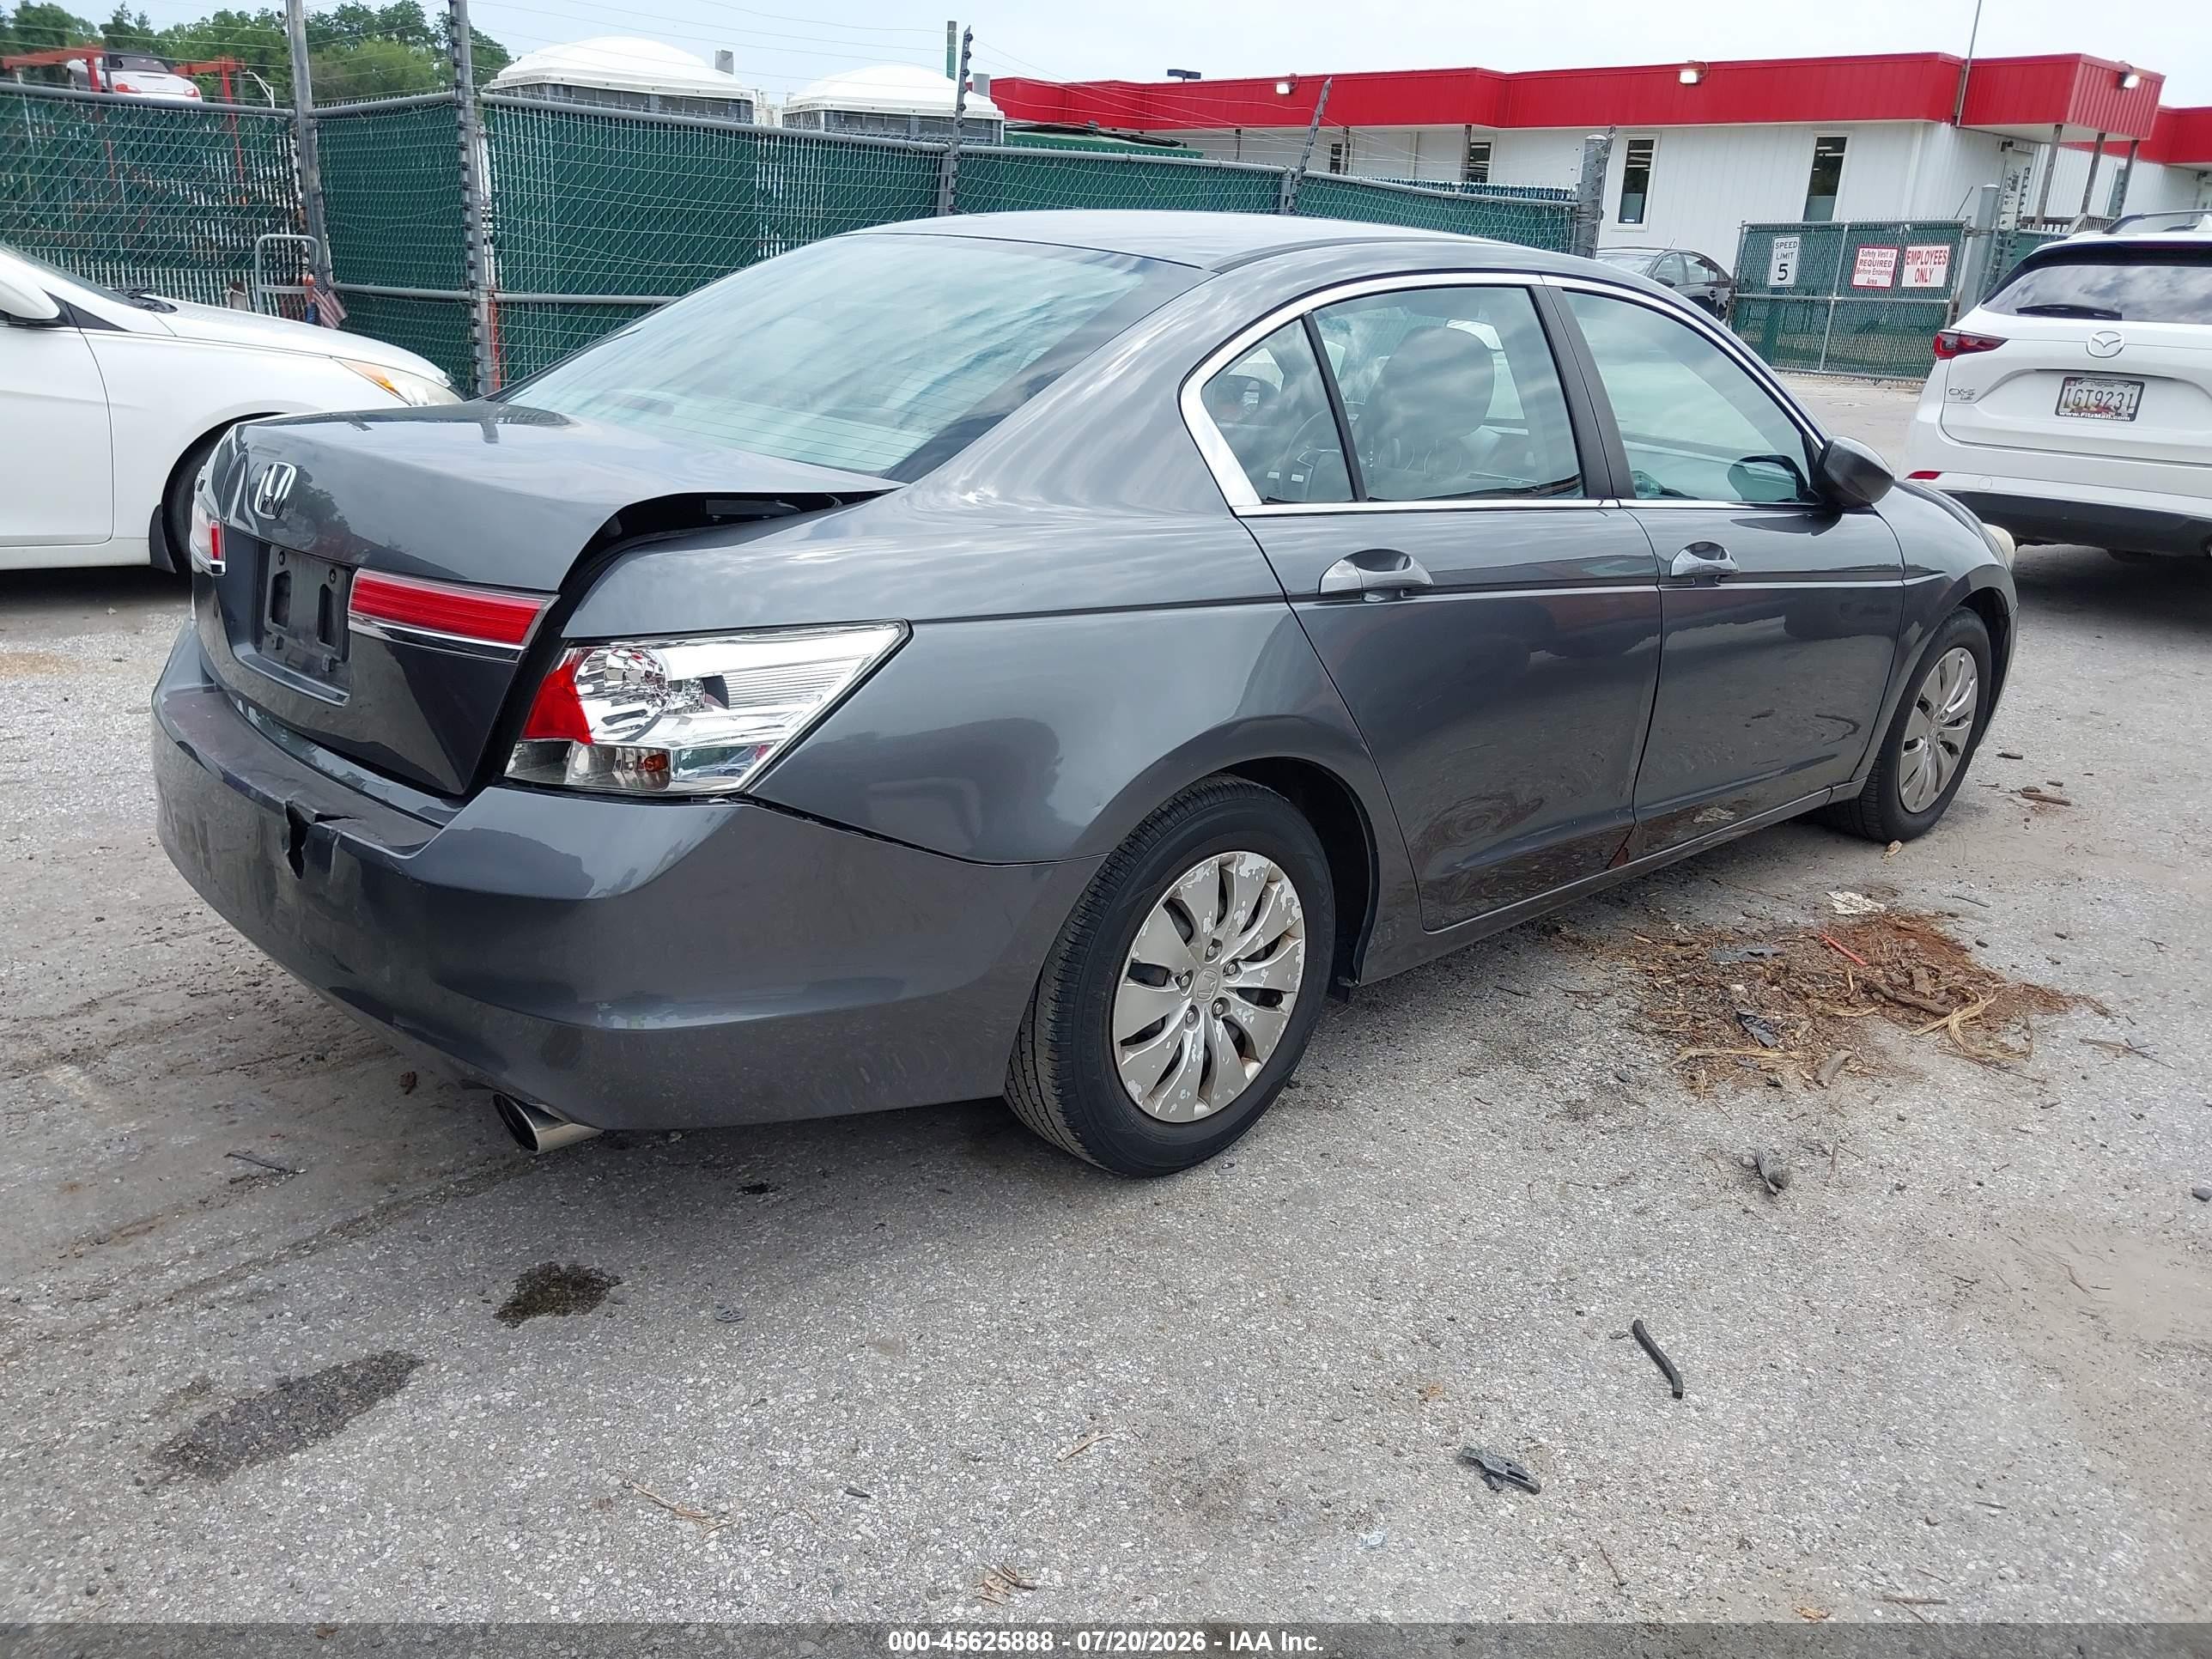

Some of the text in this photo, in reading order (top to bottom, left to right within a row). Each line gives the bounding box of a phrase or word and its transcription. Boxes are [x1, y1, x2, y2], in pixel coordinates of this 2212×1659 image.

[1861, 249, 1876, 258] Safety
[1906, 250, 1948, 265] EMPLOYEES
[1778, 264, 1789, 281] 5
[1872, 268, 1892, 278] Entering
[1914, 268, 1935, 283] ONLY
[2063, 387, 2135, 411] 1GT9231
